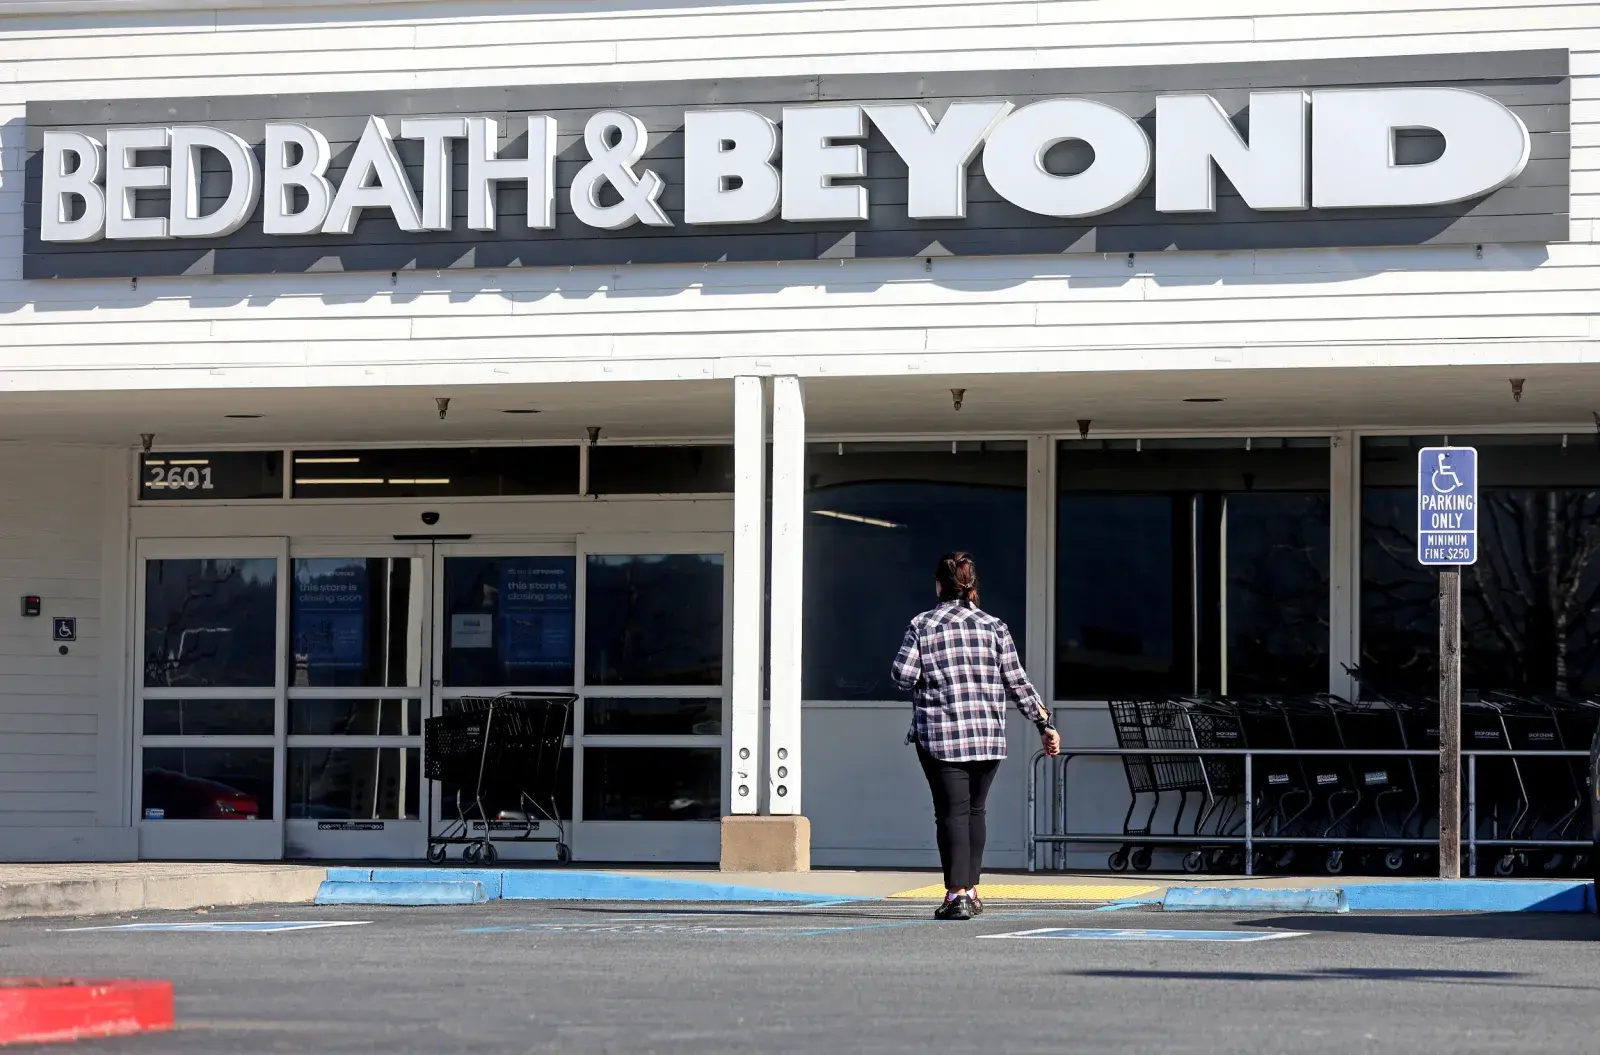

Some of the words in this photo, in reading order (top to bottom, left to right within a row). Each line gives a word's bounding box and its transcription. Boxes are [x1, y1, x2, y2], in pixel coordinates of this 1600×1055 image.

[40, 124, 261, 242] BED
[263, 114, 557, 236] BATH
[570, 110, 675, 230] &
[685, 87, 1531, 225] BEYOND
[150, 467, 214, 490] 2601
[1421, 494, 1473, 511] PARKING
[1431, 513, 1464, 529] ONLY
[1427, 534, 1467, 546] MINIMUM
[1425, 548, 1445, 560] FINE
[1448, 547, 1470, 560] $250
[299, 583, 319, 592] this
[320, 583, 347, 592] store
[348, 582, 358, 592] is
[507, 581, 527, 590] this
[529, 581, 556, 590] store
[558, 580, 568, 590] is
[299, 594, 335, 604] closing
[507, 592, 544, 603] closing
[546, 593, 572, 601] soon
